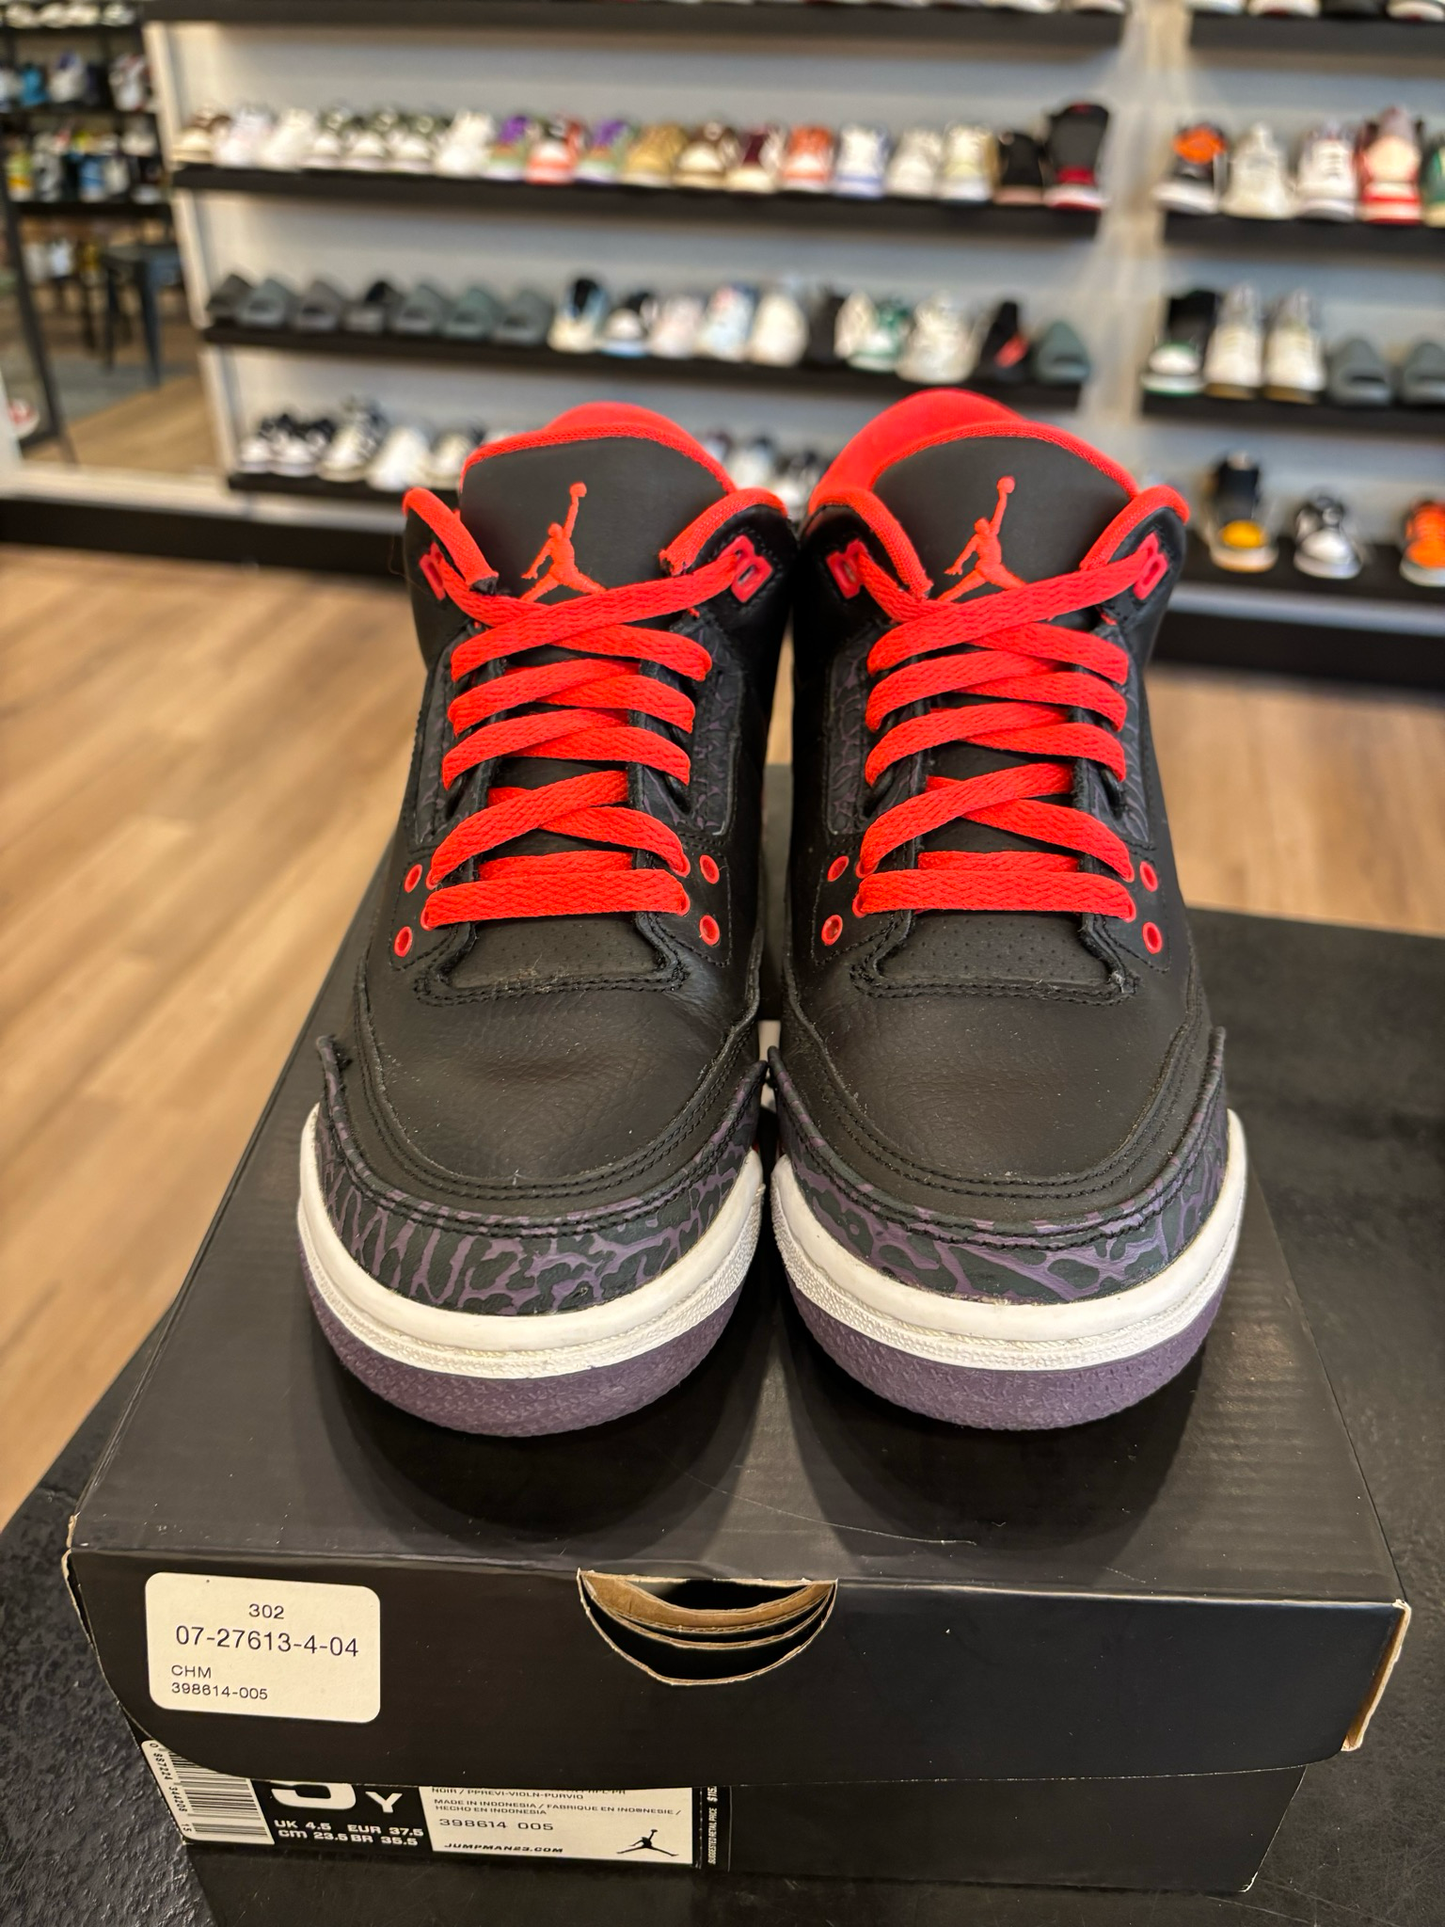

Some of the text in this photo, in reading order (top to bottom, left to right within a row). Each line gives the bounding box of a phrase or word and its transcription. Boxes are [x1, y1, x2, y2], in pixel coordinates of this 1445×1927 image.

[249, 1603, 285, 1619] 302
[175, 1625, 359, 1657] 07-27613-4-04
[171, 1664, 212, 1679] CHM
[171, 1682, 268, 1700] 398614-005
[365, 1791, 403, 1813] Y
[479, 1801, 537, 1809] INDONESIA
[490, 1807, 547, 1815] INDONESIA
[273, 1819, 424, 1837] UK 4.5 EUR 37.5
[439, 1818, 554, 1831] 398614 005
[313, 1832, 349, 1842] 23.5
[350, 1833, 374, 1843] BR
[380, 1835, 418, 1846] 35.5
[443, 1843, 564, 1853] JUMPMAN23.COM
